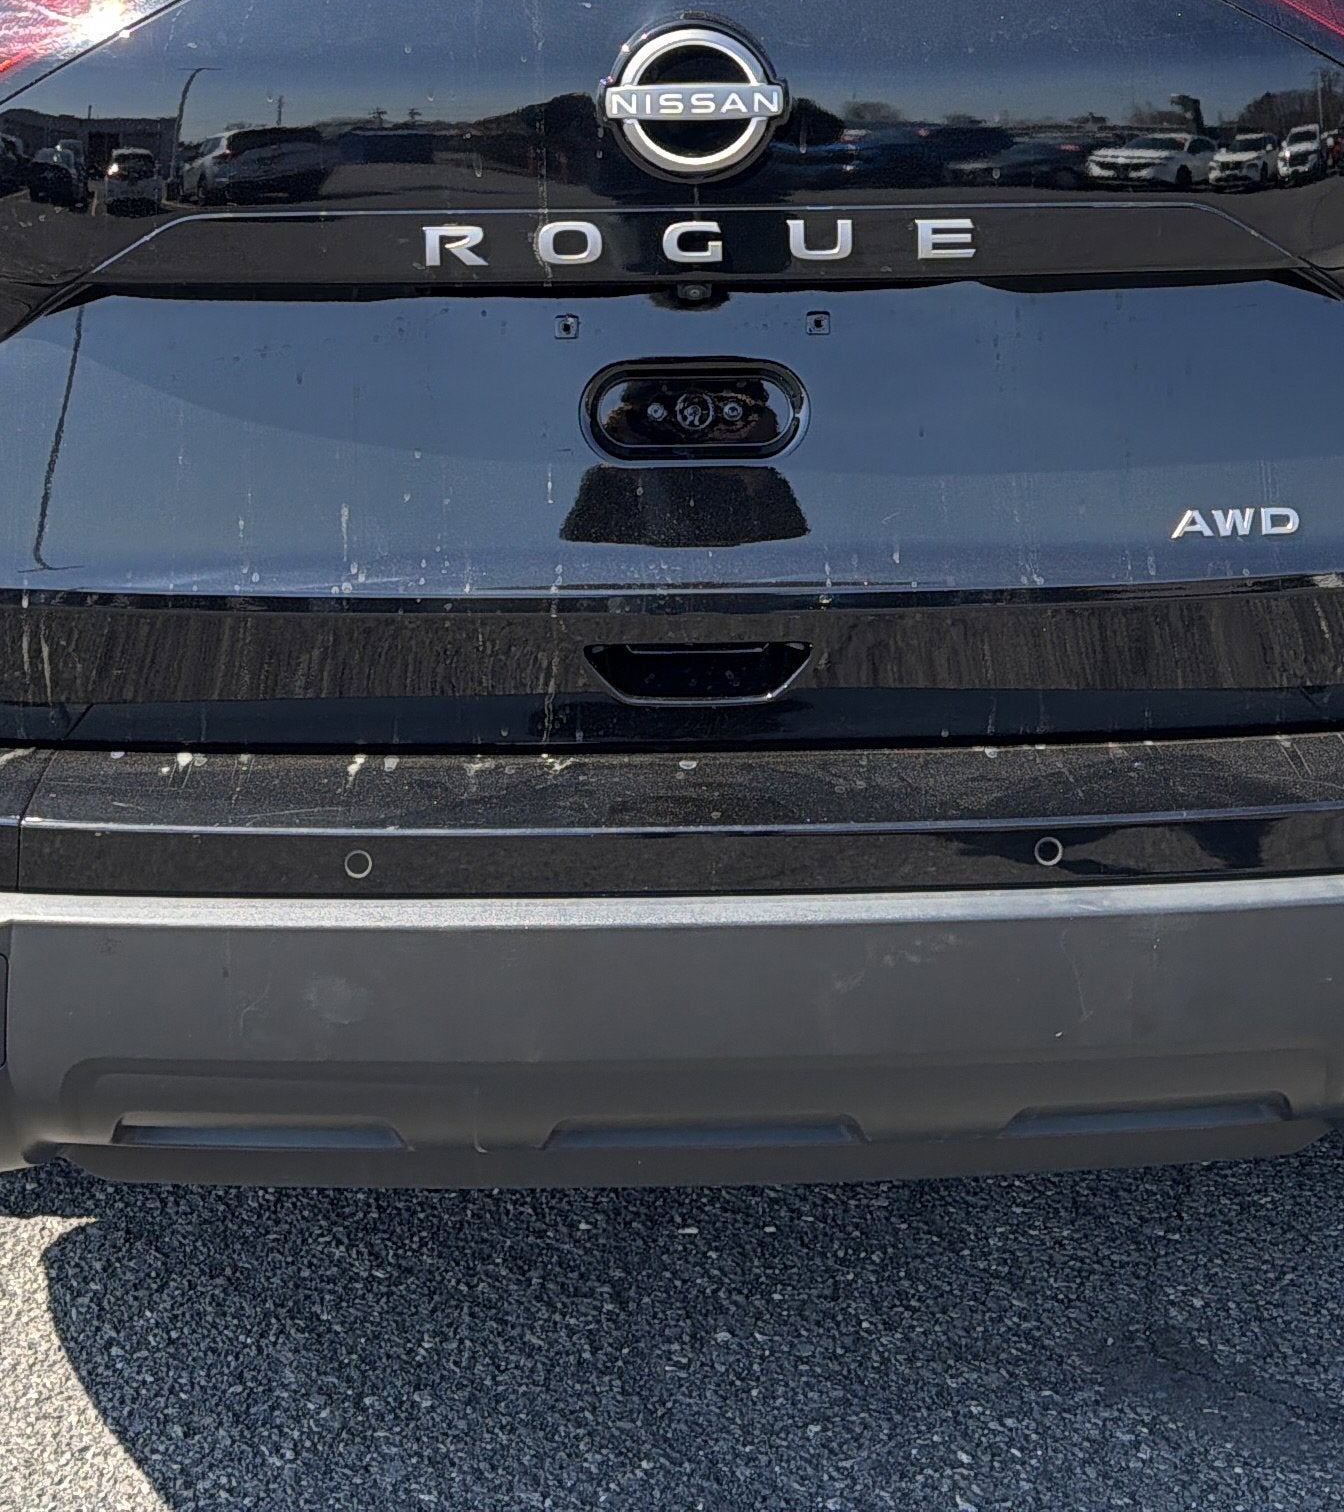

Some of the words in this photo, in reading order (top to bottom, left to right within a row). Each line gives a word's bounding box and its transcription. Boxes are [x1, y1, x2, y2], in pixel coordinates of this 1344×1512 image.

[610, 91, 780, 115] NISSAN
[421, 218, 977, 267] ROGUE
[1170, 506, 1301, 539] AWD
